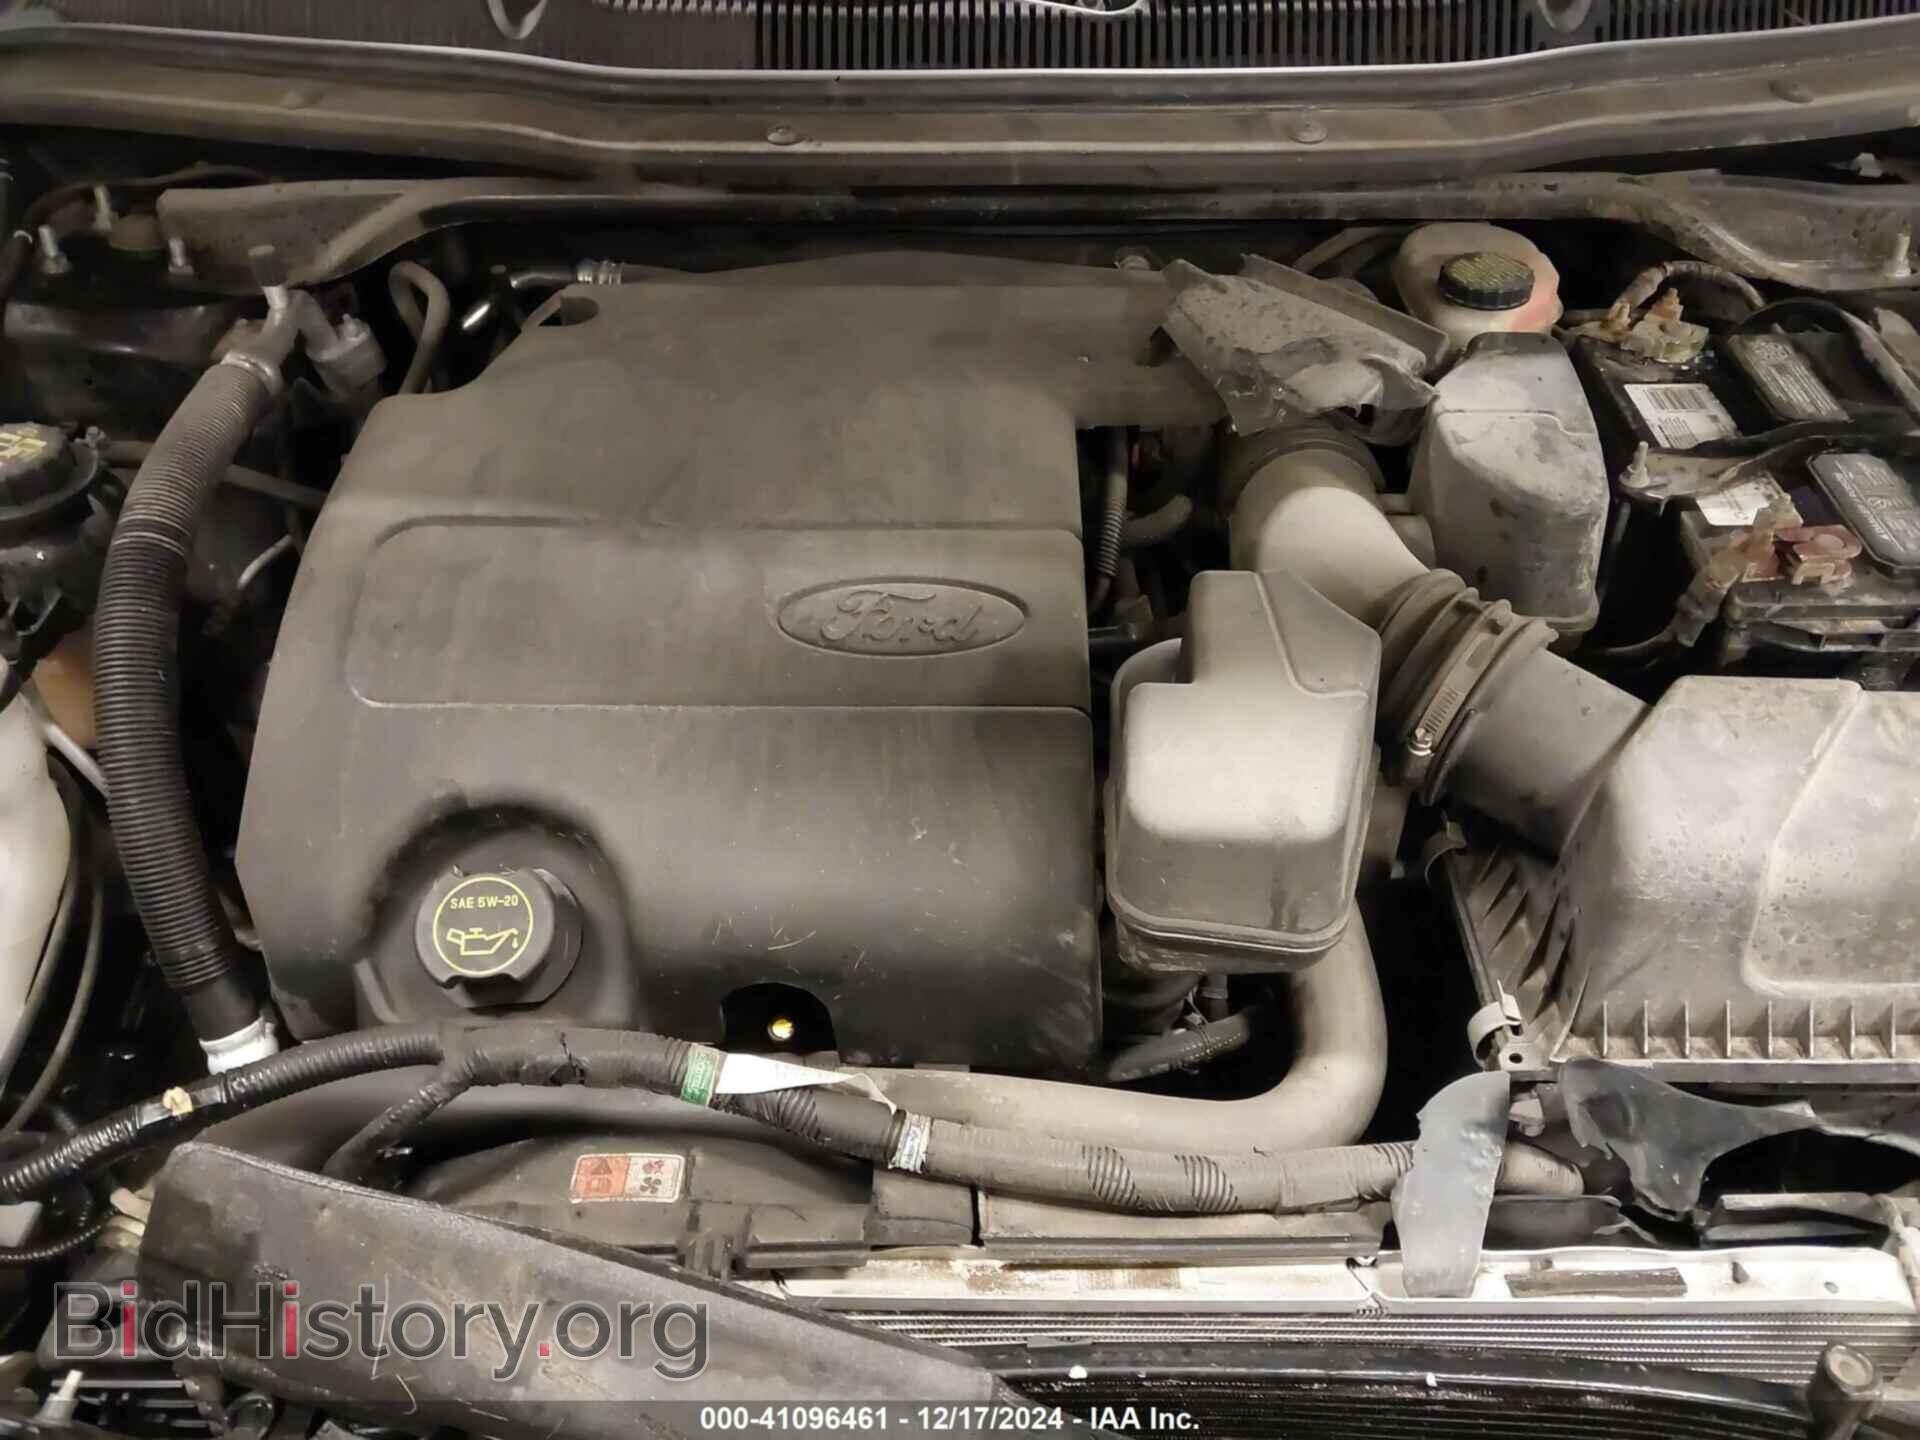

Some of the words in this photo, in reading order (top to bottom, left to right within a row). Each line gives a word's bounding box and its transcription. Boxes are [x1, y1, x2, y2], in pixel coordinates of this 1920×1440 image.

[820, 590, 982, 643] Ford
[450, 896, 474, 909] SAE
[478, 894, 519, 908] 5W-20
